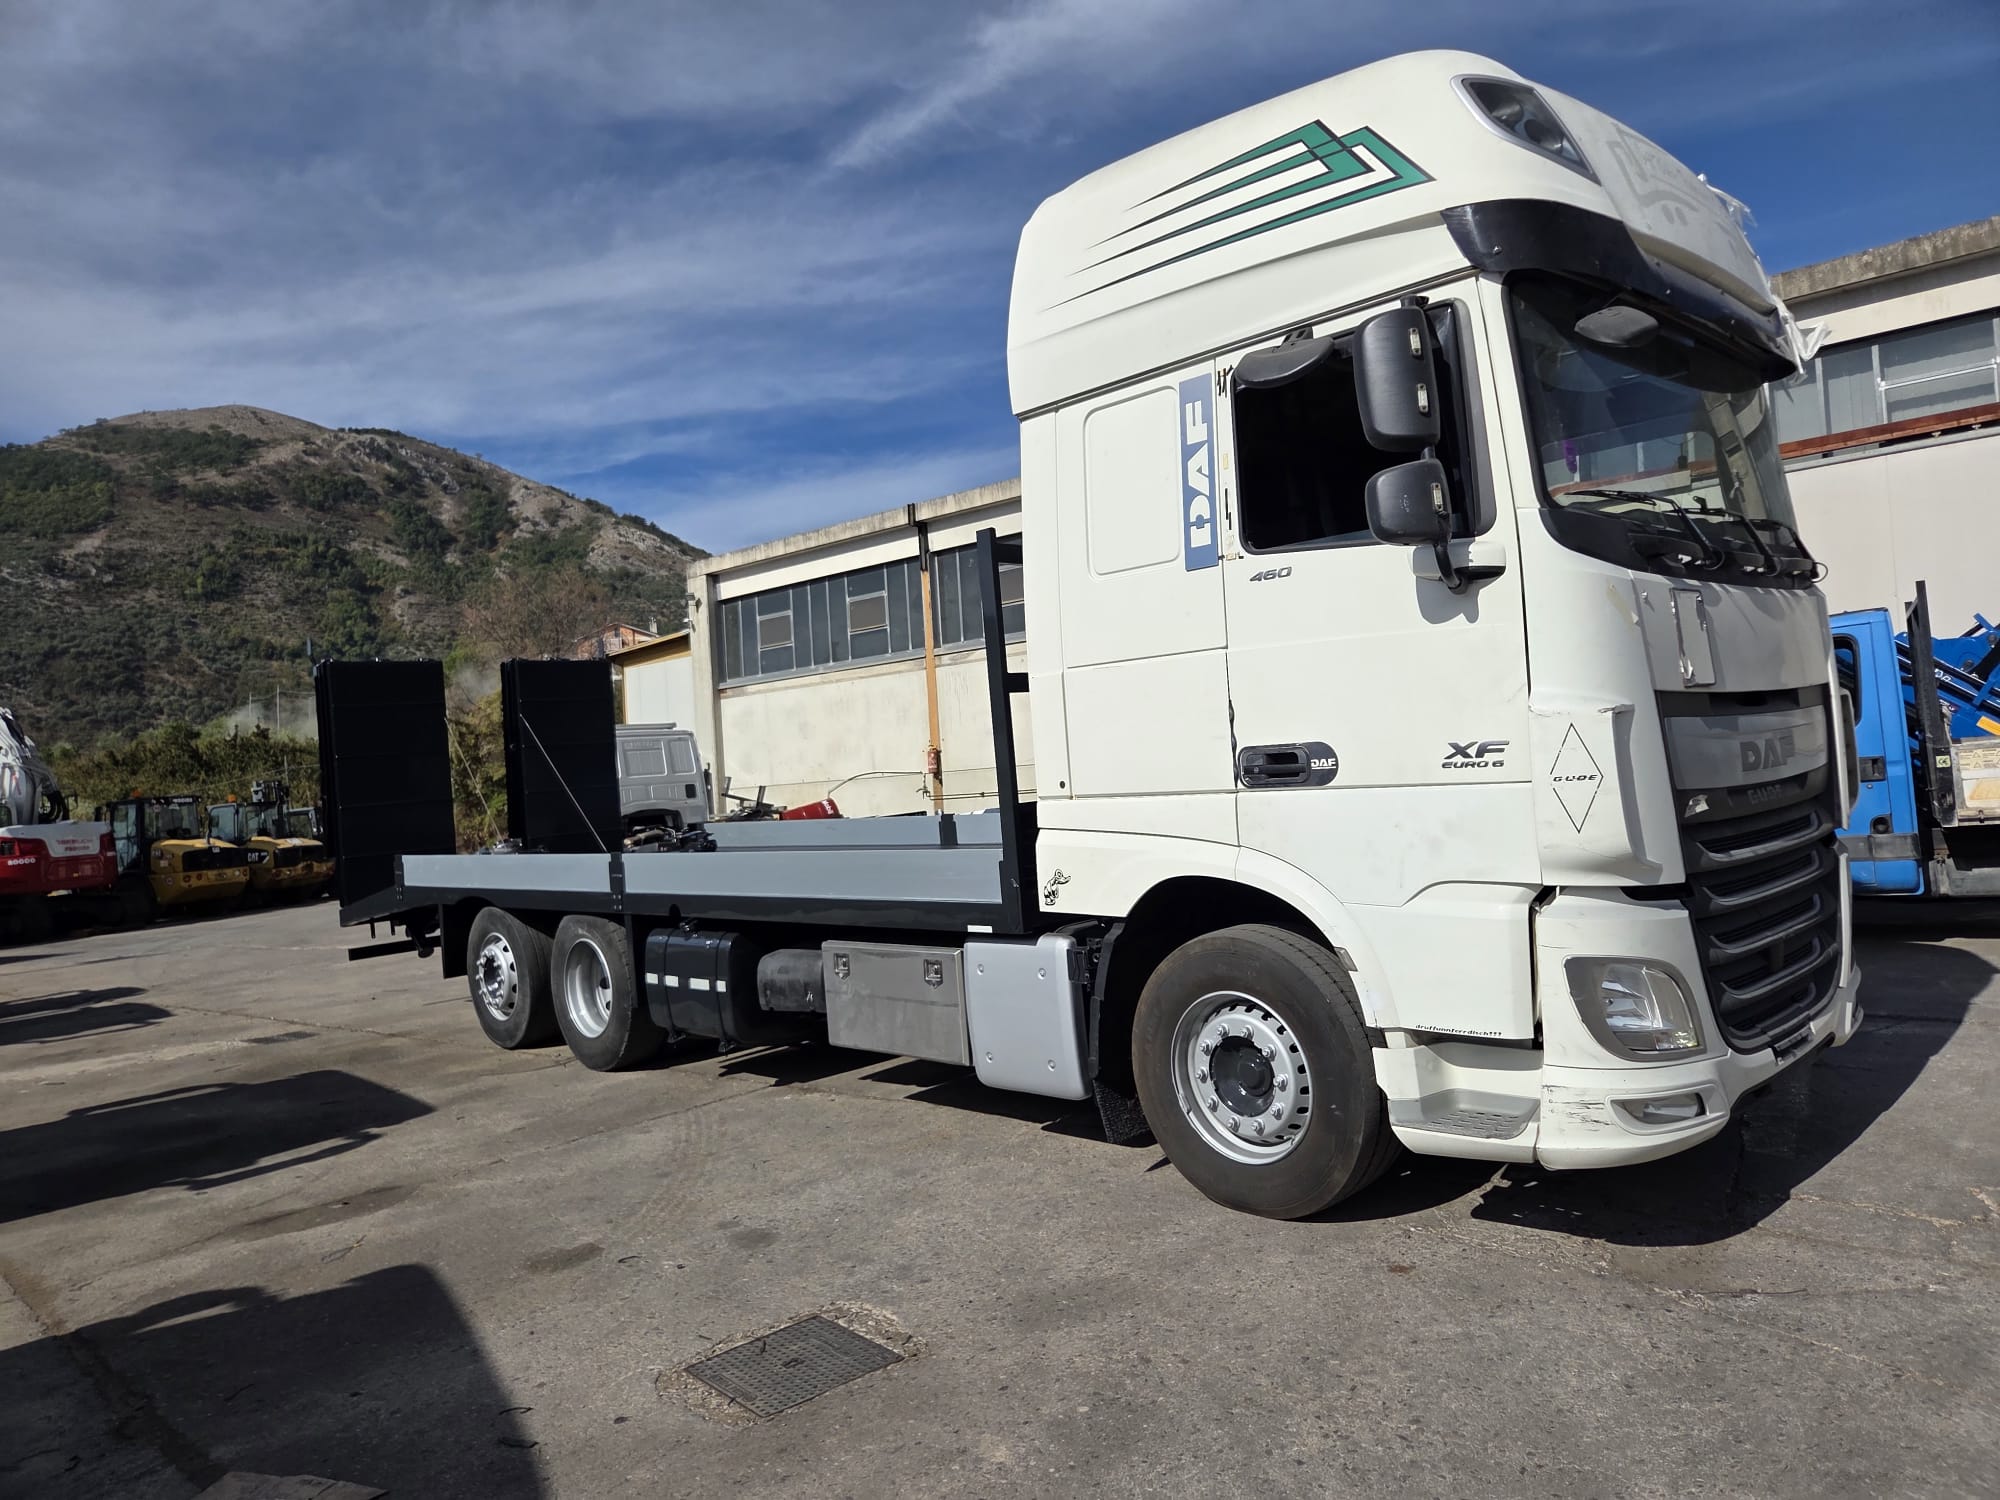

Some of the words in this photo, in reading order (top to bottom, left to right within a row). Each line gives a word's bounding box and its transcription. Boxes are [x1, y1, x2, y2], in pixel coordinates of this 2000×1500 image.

[1185, 400, 1211, 548] DAF
[1250, 566, 1292, 582] 460
[1444, 741, 1509, 759] XF
[1740, 734, 1795, 772] DAF
[1310, 757, 1337, 768] DAF
[1442, 760, 1489, 768] EURO
[1492, 760, 1505, 768] 6
